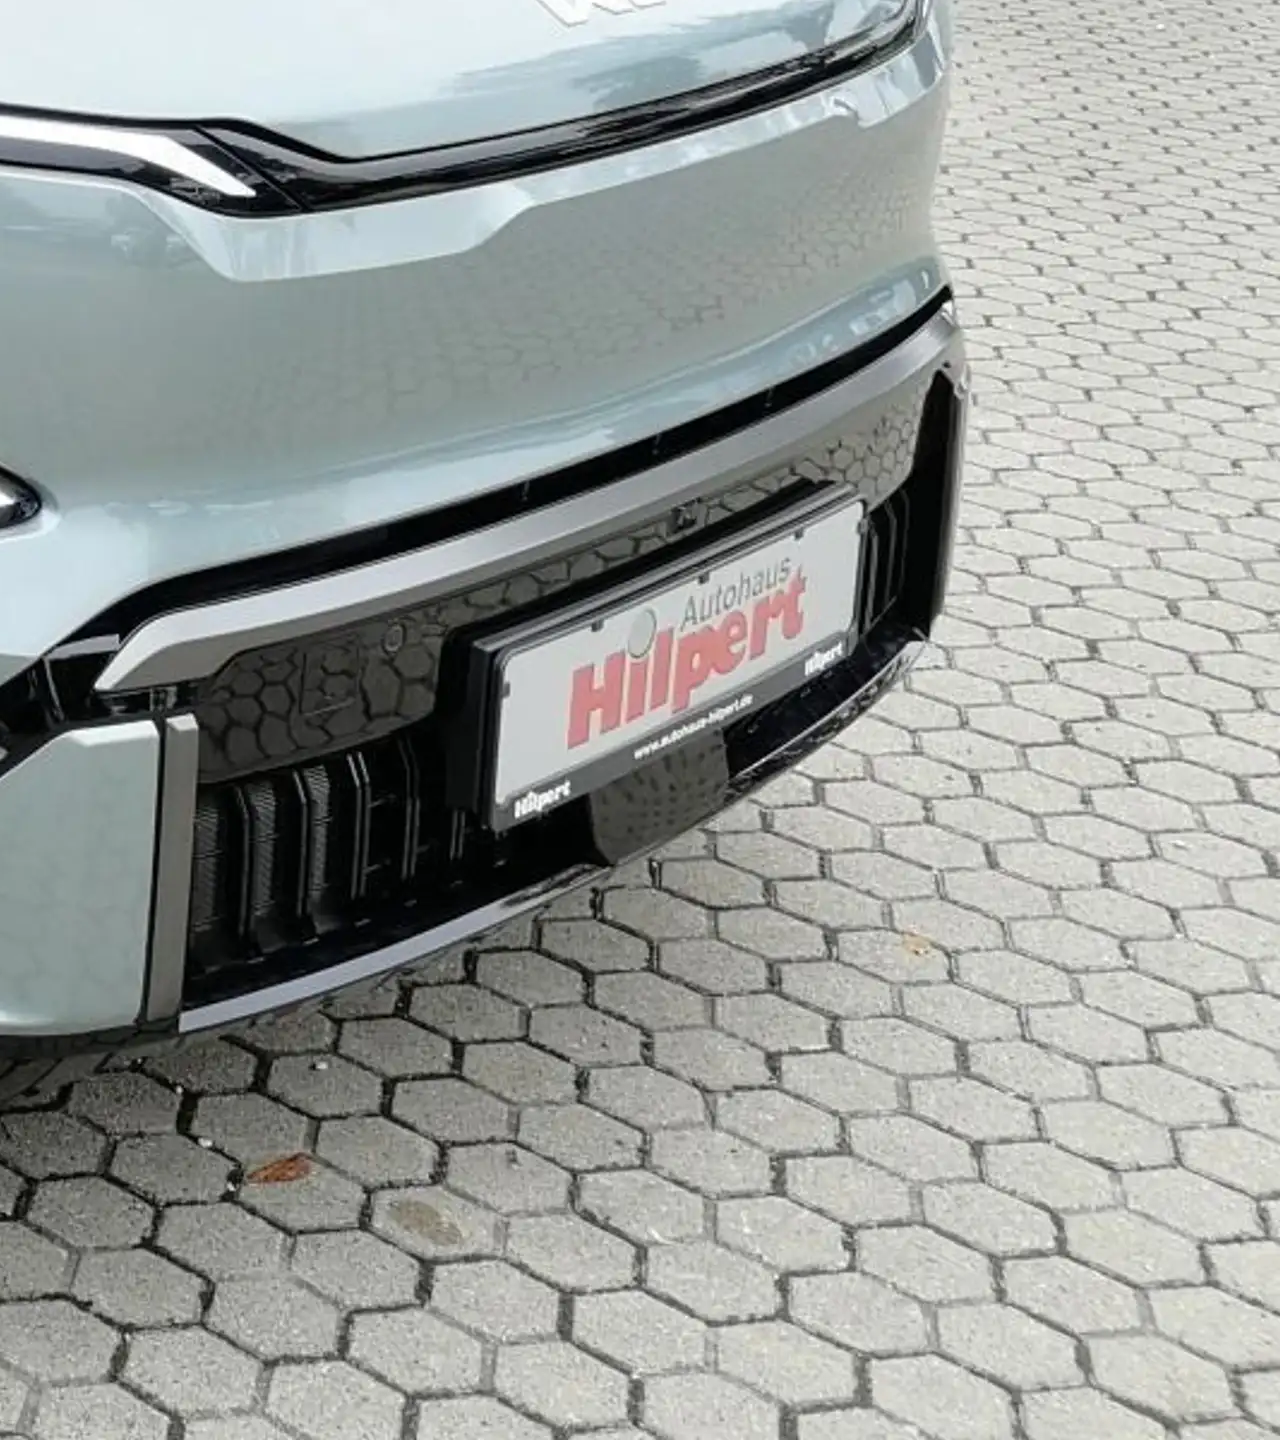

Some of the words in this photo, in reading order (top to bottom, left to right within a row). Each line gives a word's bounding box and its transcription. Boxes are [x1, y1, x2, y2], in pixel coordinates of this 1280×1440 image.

[679, 556, 792, 633] Autohaus
[566, 565, 808, 750] Hilpert
[633, 693, 754, 761] www.autohaus-hilpert.de
[513, 778, 571, 819] Hilpert
